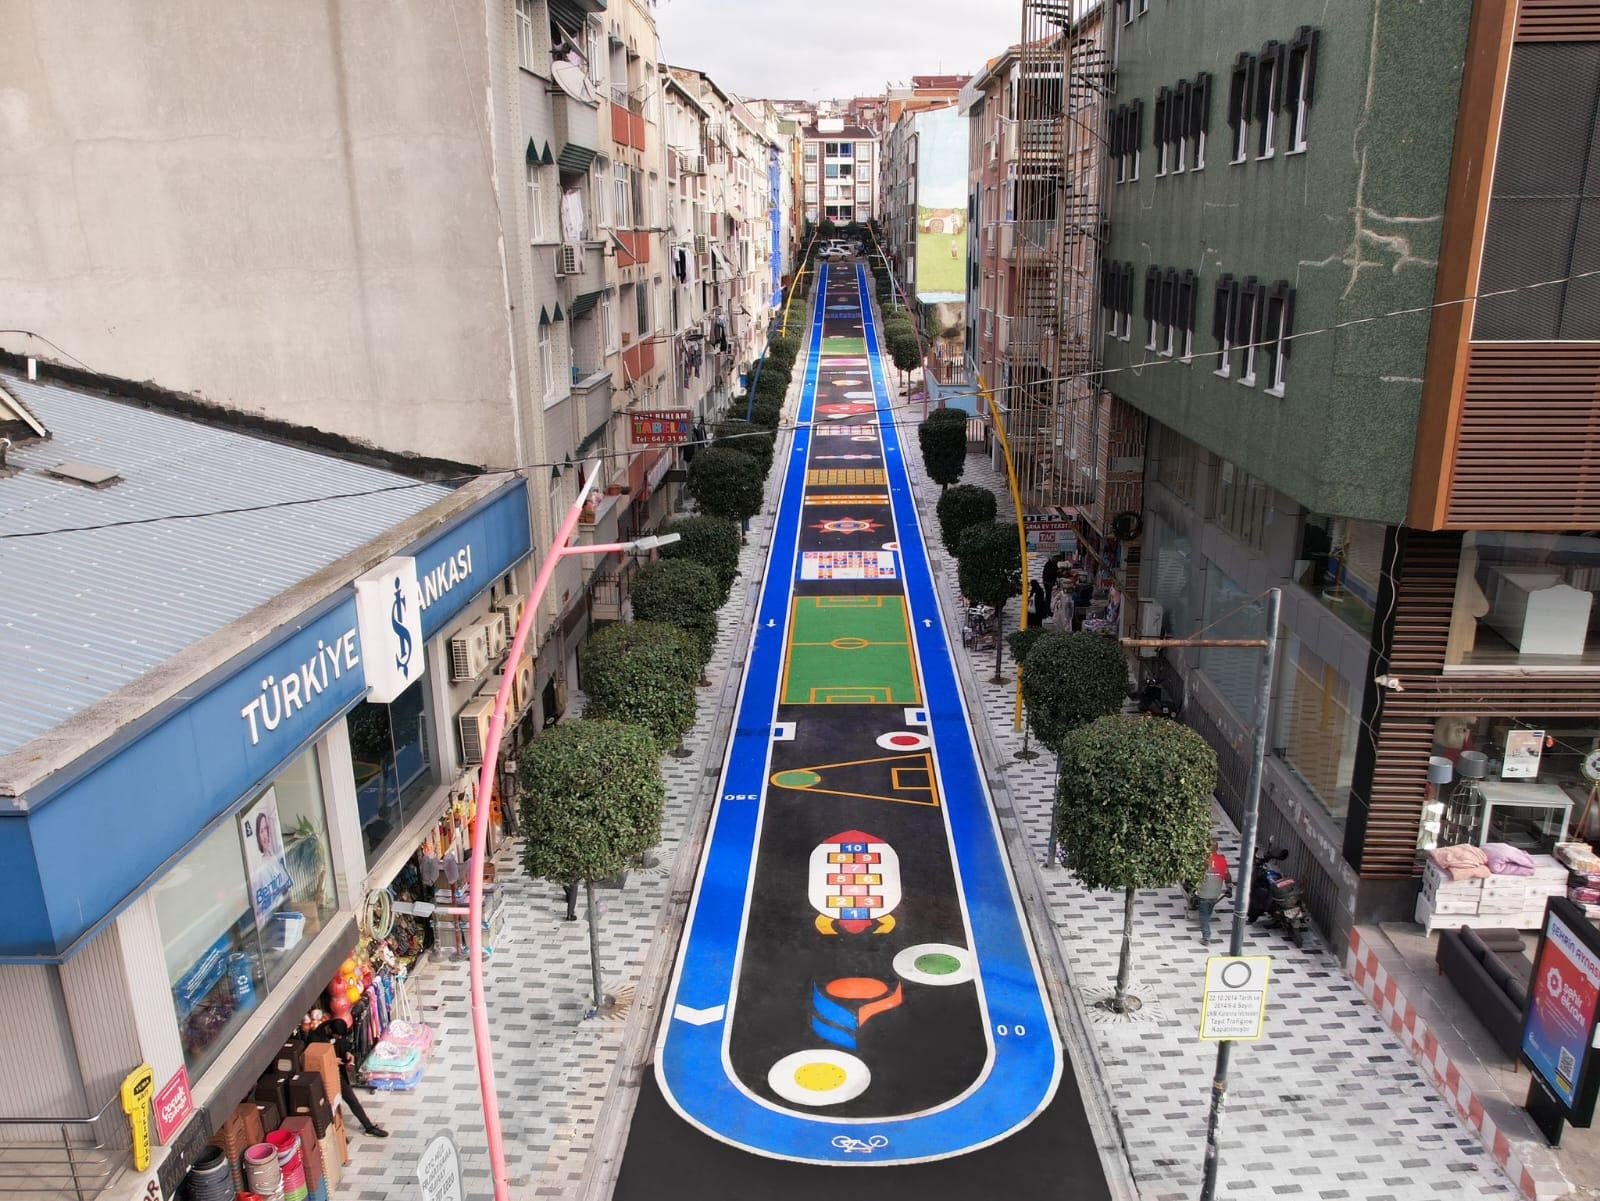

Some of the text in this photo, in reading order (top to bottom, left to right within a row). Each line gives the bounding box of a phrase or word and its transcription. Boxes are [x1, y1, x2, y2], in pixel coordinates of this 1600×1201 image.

[634, 421, 688, 433] TABELA
[241, 544, 473, 745] TÜRKİYE ANKASI
[845, 844, 862, 852] 10
[863, 898, 875, 906] 3
[850, 910, 859, 918] 1
